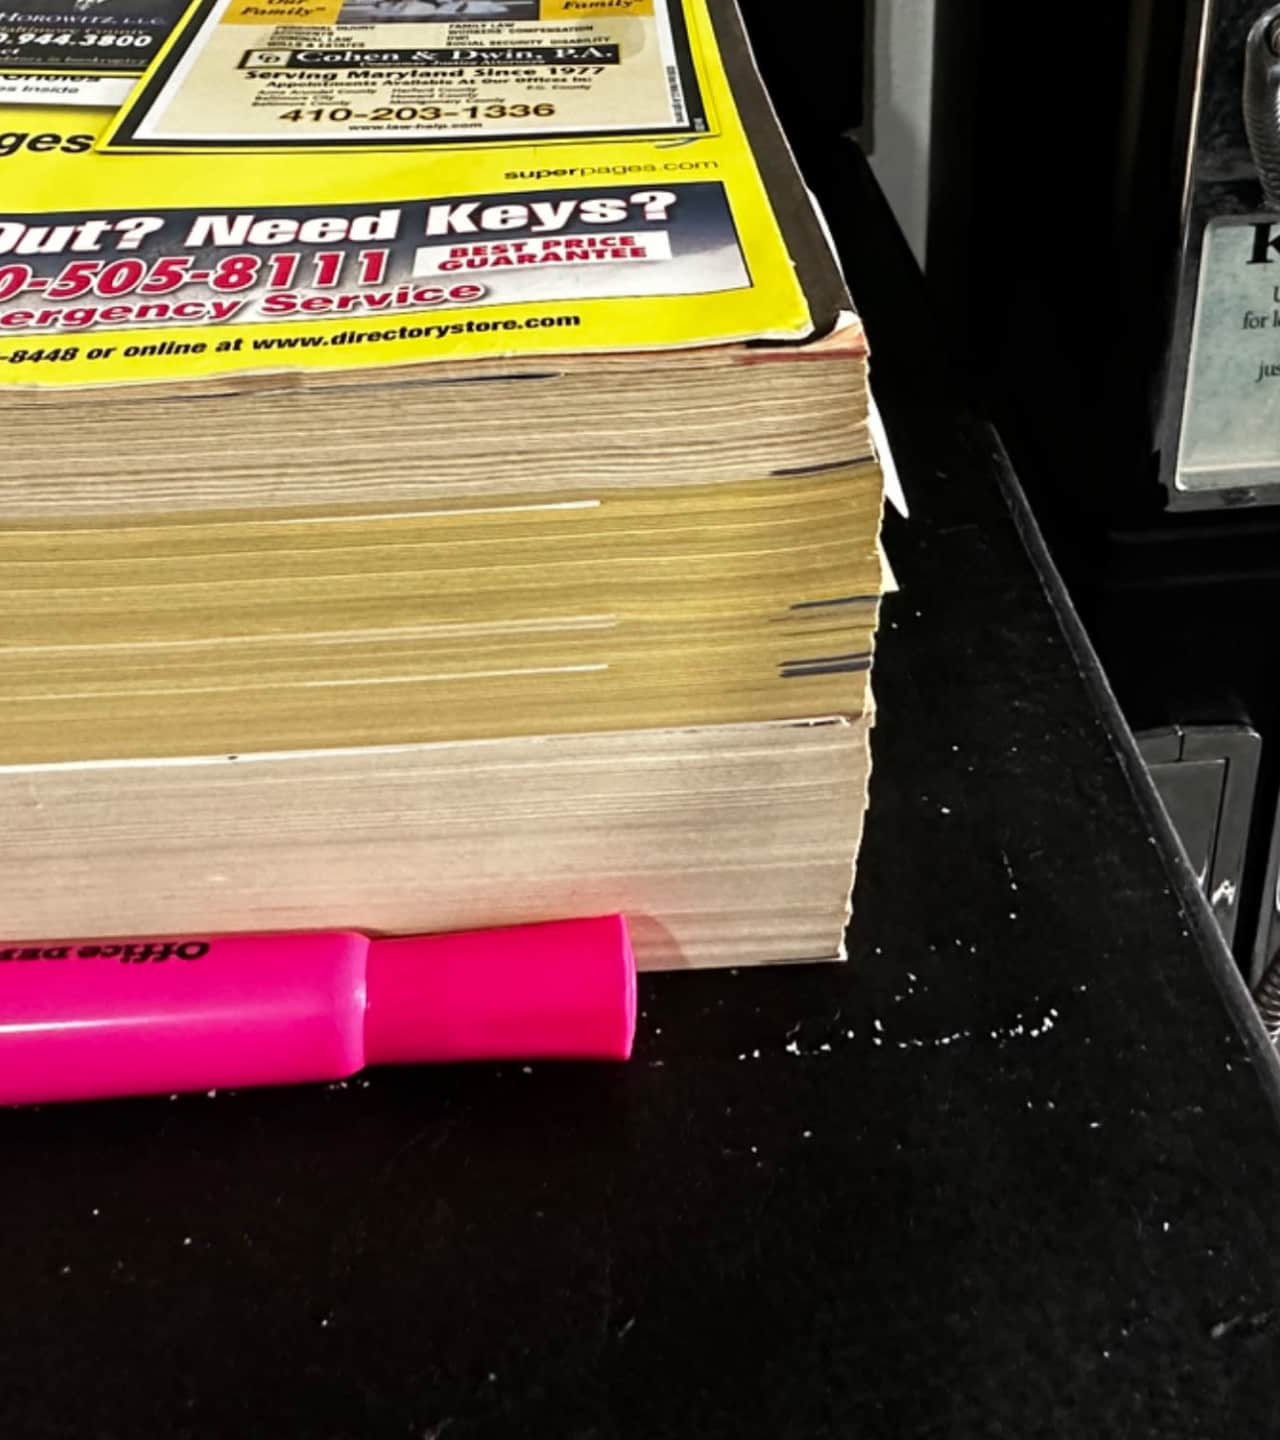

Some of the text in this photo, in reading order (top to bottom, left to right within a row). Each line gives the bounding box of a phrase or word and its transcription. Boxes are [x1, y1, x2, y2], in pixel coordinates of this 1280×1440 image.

[295, 50, 401, 63] Cohen
[411, 50, 436, 61] &
[555, 48, 614, 59] P.A.
[245, 66, 605, 81] Serving Maryland Since 1977
[278, 103, 556, 122] 410-203-1336
[504, 161, 720, 180] superpages.com
[184, 209, 402, 247] Need
[425, 191, 677, 237] Keys?
[449, 235, 635, 258] BEST PRICE
[437, 247, 646, 271] GUARANTEE
[261, 283, 486, 316] Service
[1242, 313, 1269, 330] for
[86, 347, 116, 360] or
[123, 341, 208, 357] online
[216, 338, 242, 352] at
[252, 315, 581, 350] www.directorystore.com
[77, 942, 210, 964] Office
